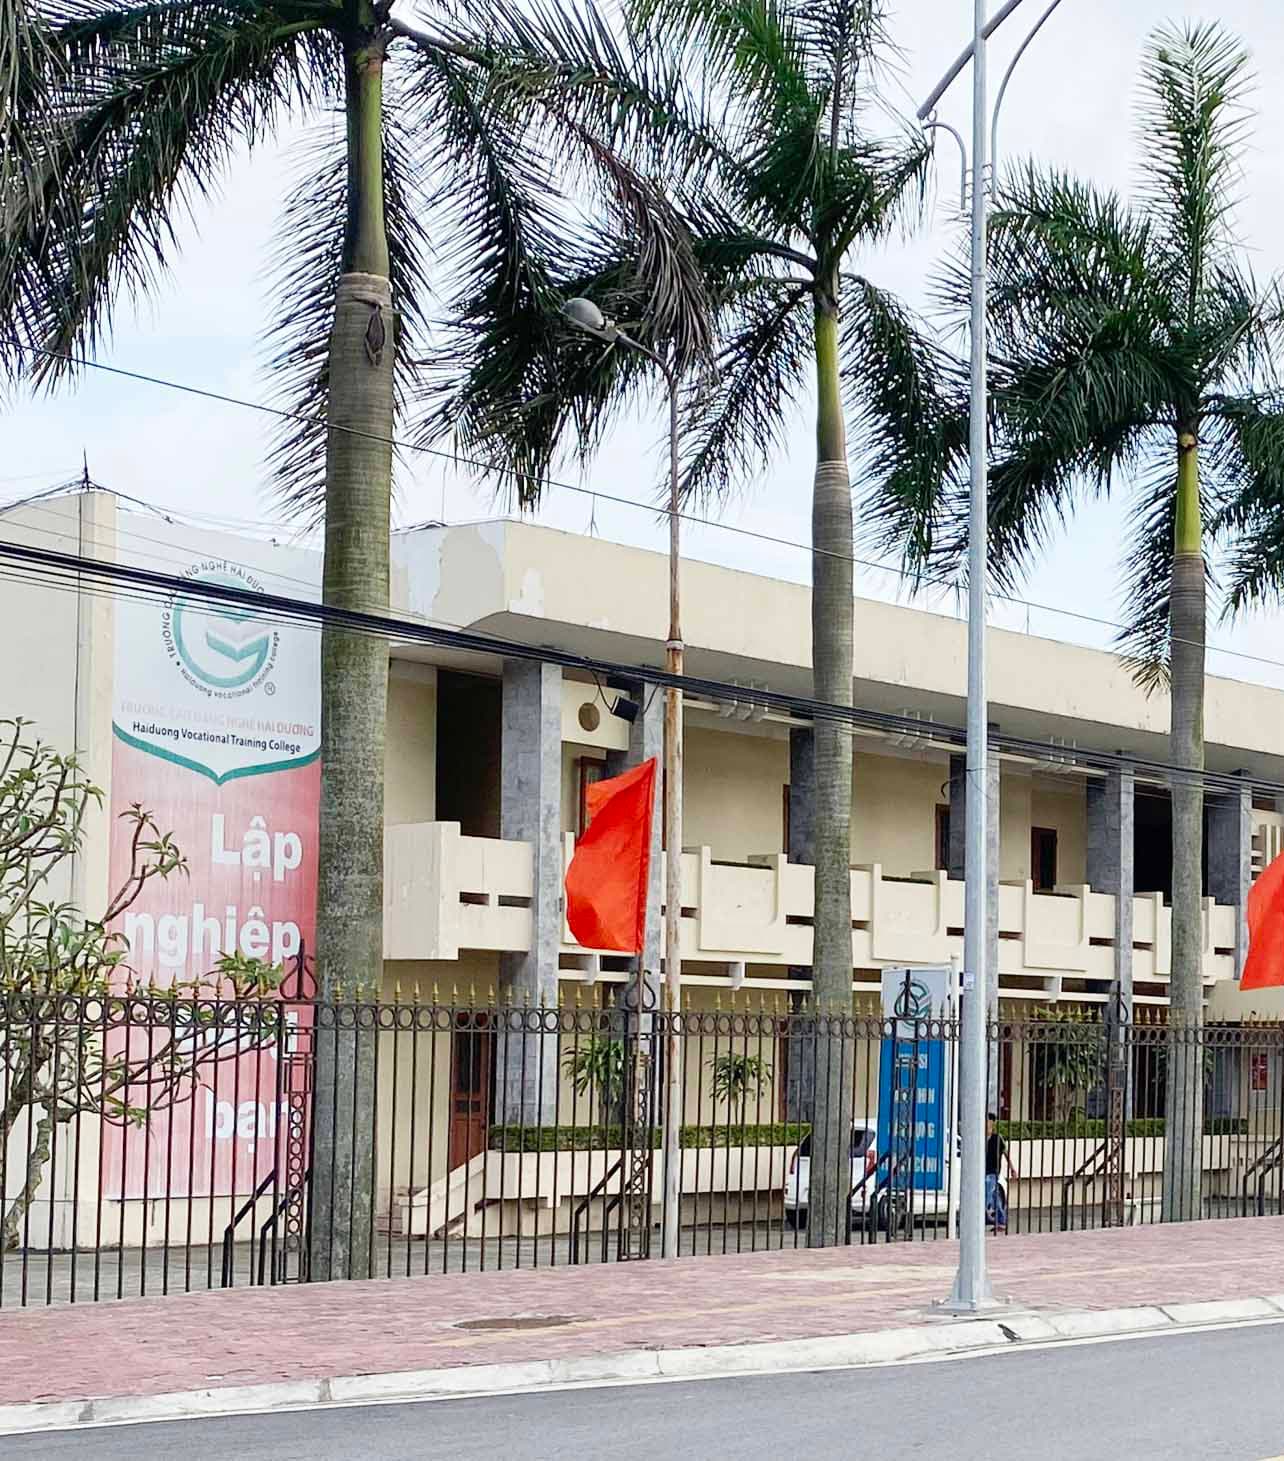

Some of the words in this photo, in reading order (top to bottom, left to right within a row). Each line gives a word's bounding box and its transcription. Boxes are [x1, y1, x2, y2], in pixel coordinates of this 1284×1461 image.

[132, 721, 180, 740] Haiduong
[181, 728, 230, 745] Vocational
[230, 734, 267, 751] Training
[268, 738, 301, 755] College
[211, 813, 303, 881] Lập
